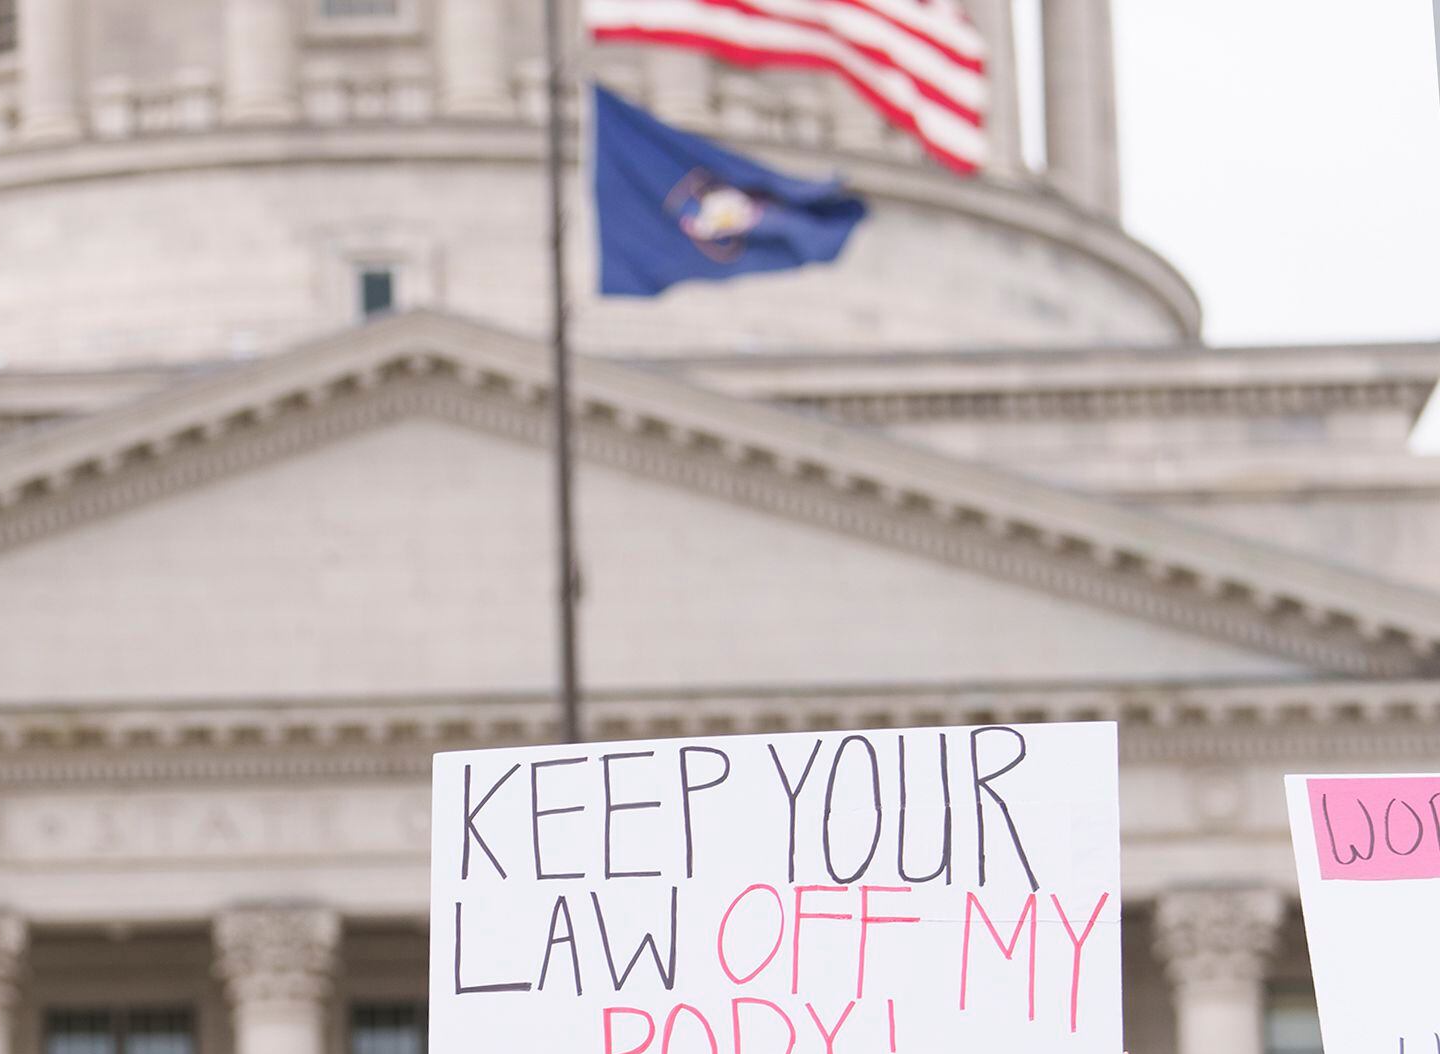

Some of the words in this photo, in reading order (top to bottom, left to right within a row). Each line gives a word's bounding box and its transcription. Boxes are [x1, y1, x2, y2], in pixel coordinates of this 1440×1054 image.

[461, 745, 731, 881] KEEP
[767, 726, 1040, 892] YOUR
[1322, 792, 1440, 865] WO
[454, 886, 678, 996] LAW
[717, 883, 921, 999] OFF
[959, 891, 1109, 1033] MY
